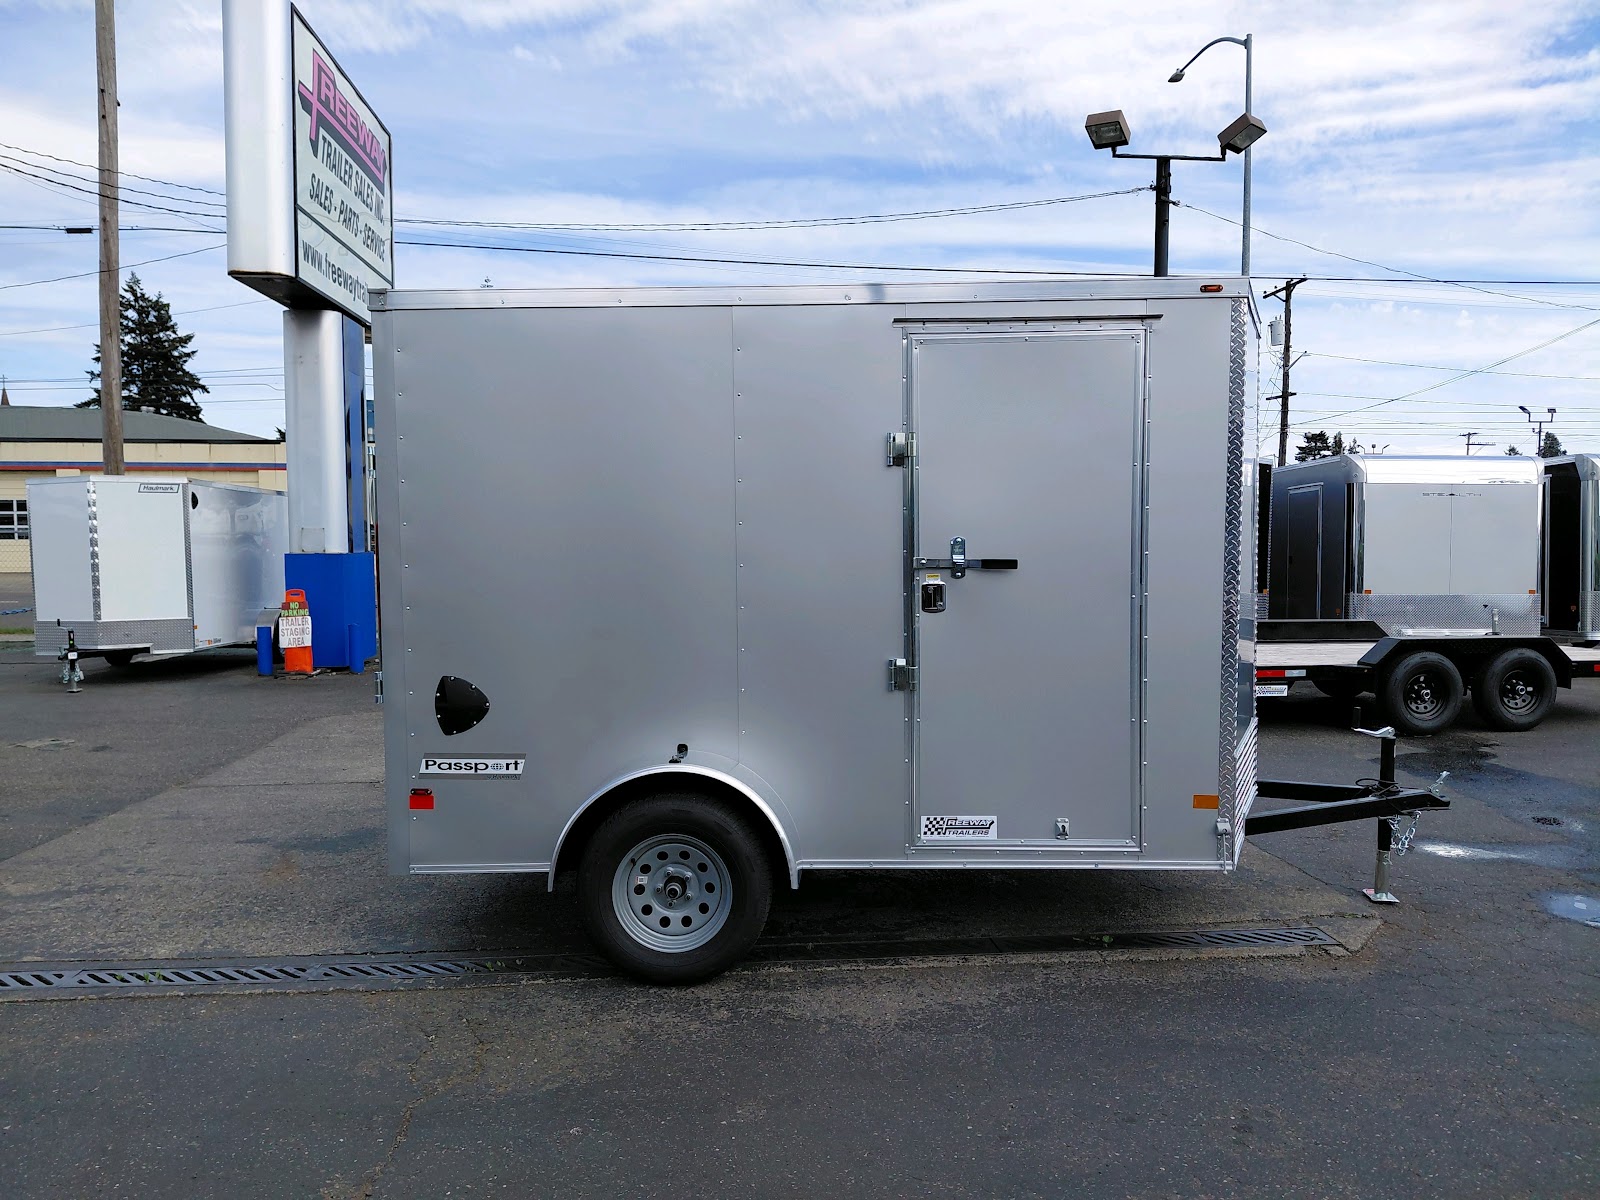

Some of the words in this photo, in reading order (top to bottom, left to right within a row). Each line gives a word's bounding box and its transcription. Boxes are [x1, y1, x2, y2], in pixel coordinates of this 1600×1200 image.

[298, 47, 386, 184] FREEWAY
[321, 133, 354, 193] TRAILER
[353, 169, 374, 213] SALES
[309, 172, 334, 215] SALES
[338, 198, 360, 238] PARTS
[362, 222, 386, 263] SERVICE
[289, 601, 300, 609] NO
[281, 609, 309, 617] PARKING
[280, 616, 310, 627] TRAILER
[280, 627, 310, 638] STAGING
[287, 636, 305, 647] AREA
[424, 759, 521, 773] Passport
[940, 817, 995, 833] FREEWAY
